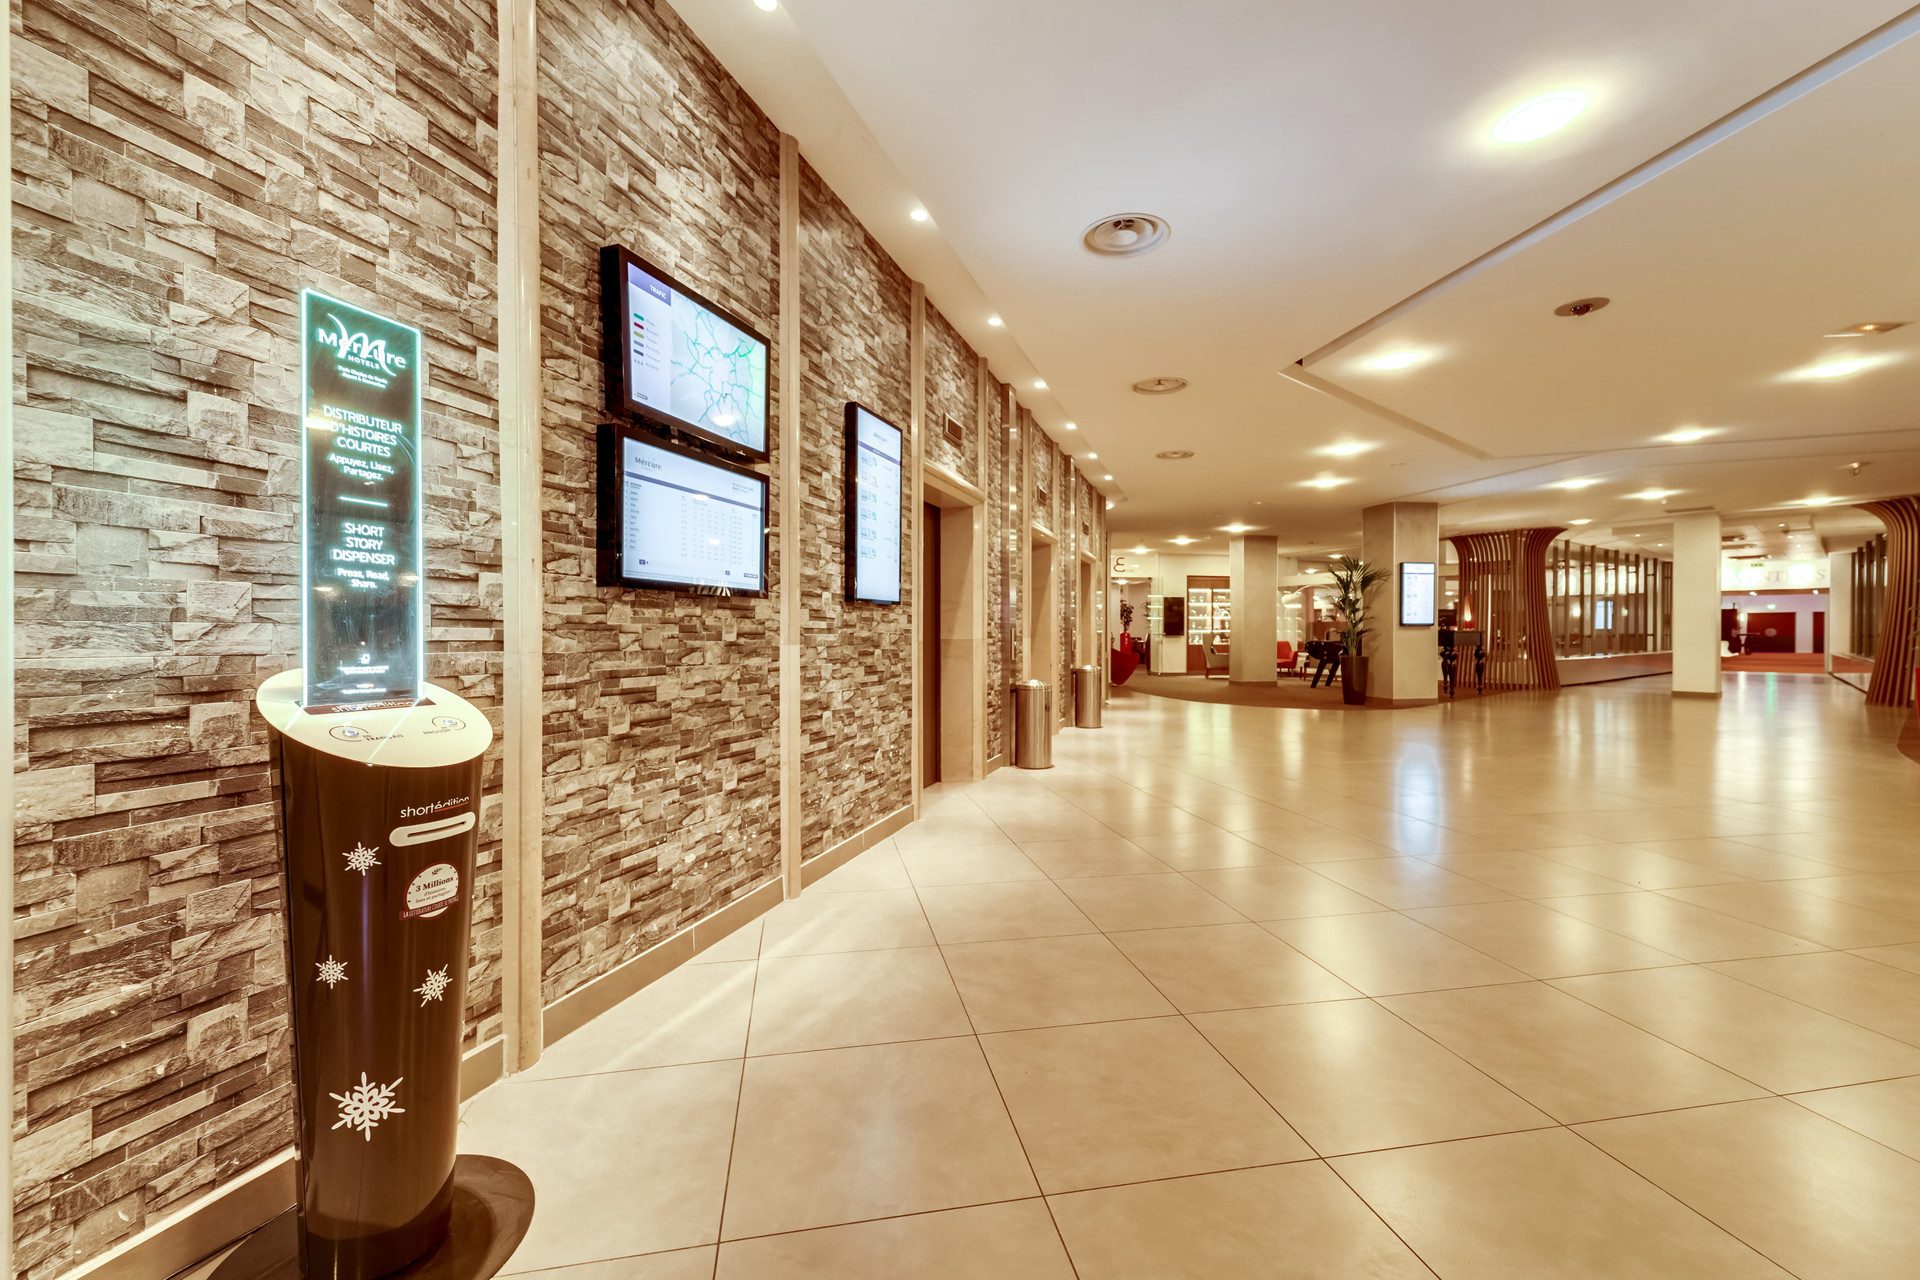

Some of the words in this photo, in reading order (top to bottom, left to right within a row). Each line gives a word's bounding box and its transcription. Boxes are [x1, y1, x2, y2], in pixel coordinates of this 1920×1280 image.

[649, 284, 667, 300] TRAFIC
[347, 354, 380, 370] HOTELS
[323, 405, 403, 434] DISTRIBUTEUR
[330, 421, 398, 446] D'HISTOIRES
[335, 436, 391, 458] COURTES
[329, 452, 369, 469] Appuyez,
[370, 461, 394, 475] Lisez,
[634, 456, 662, 470] Mercure
[343, 465, 384, 480] Partagez.
[344, 521, 385, 537] SHORT
[345, 536, 383, 550] STORY
[332, 548, 395, 566] DISPENSER
[337, 567, 365, 579] Press,
[400, 795, 470, 818] shortédition
[415, 884, 421, 893] 3
[422, 876, 454, 891] Millions
